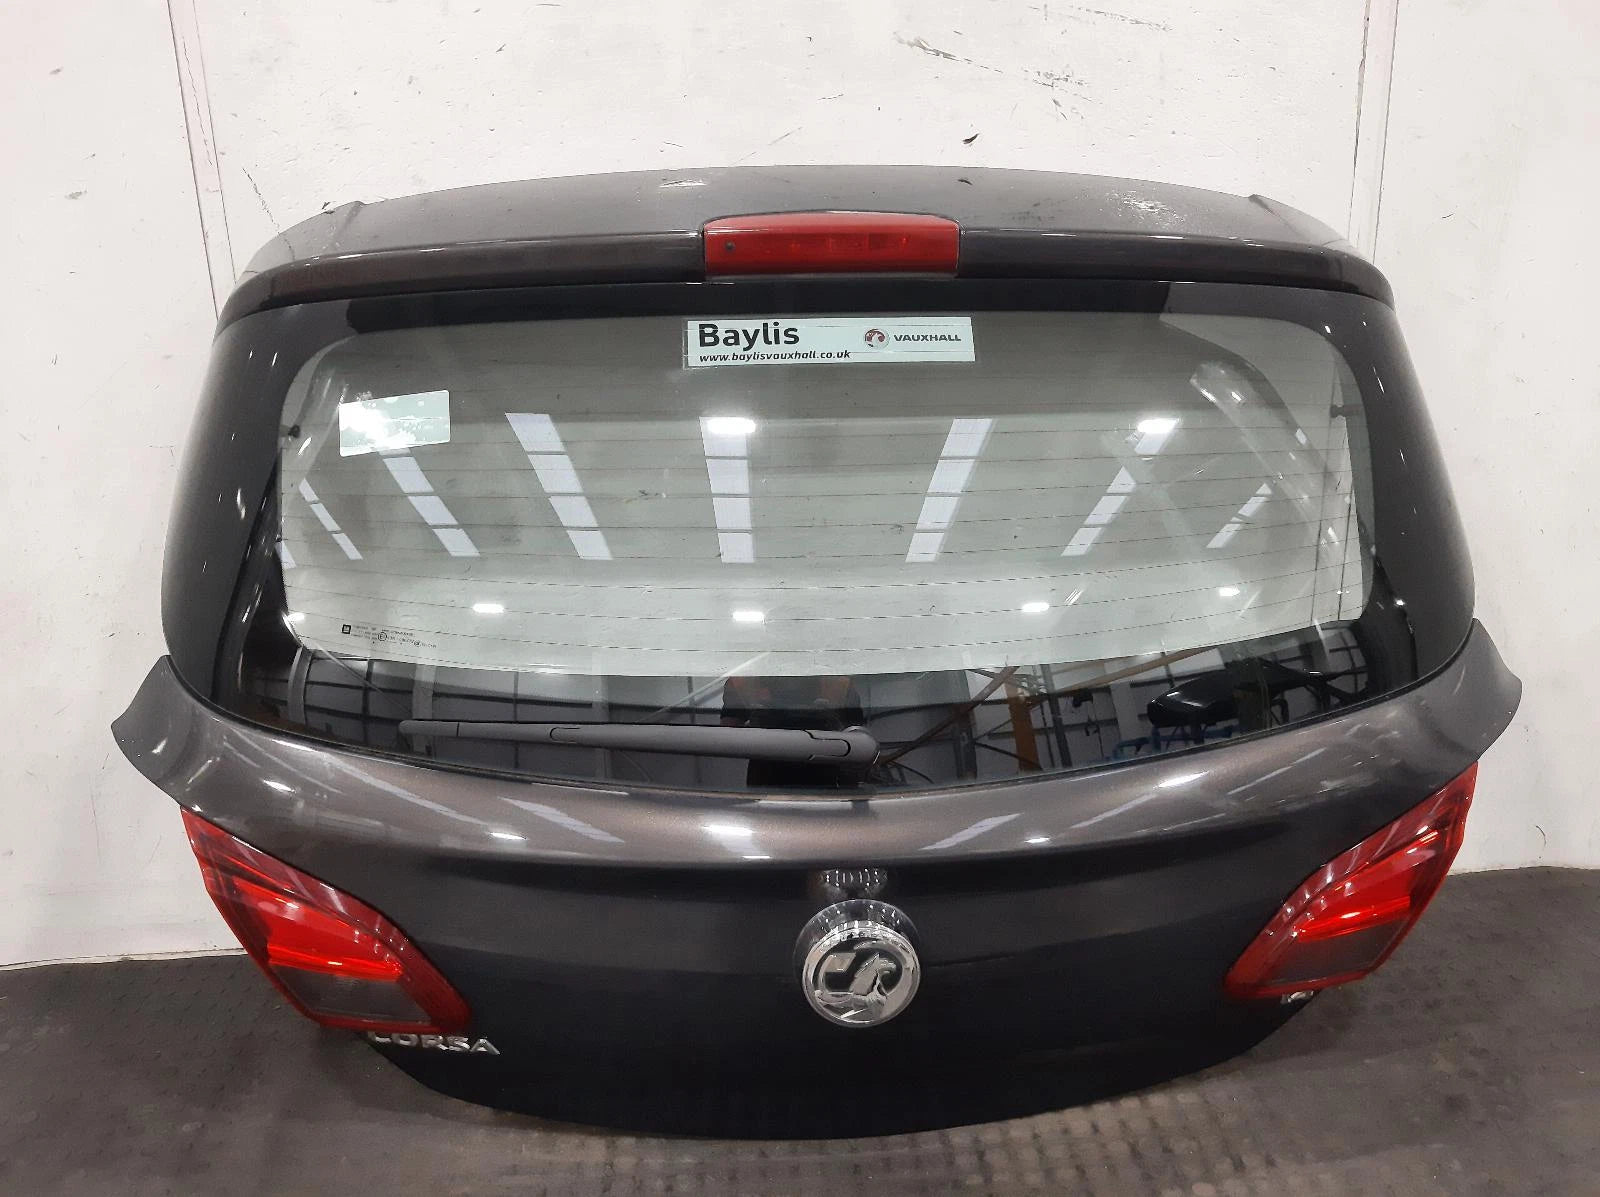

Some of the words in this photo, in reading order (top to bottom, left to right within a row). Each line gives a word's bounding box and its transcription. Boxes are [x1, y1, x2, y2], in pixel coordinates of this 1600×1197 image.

[699, 322, 800, 351] Baylis
[893, 333, 962, 342] VAUXHALL
[700, 350, 851, 363] www.baylisvauxhall.co.uk
